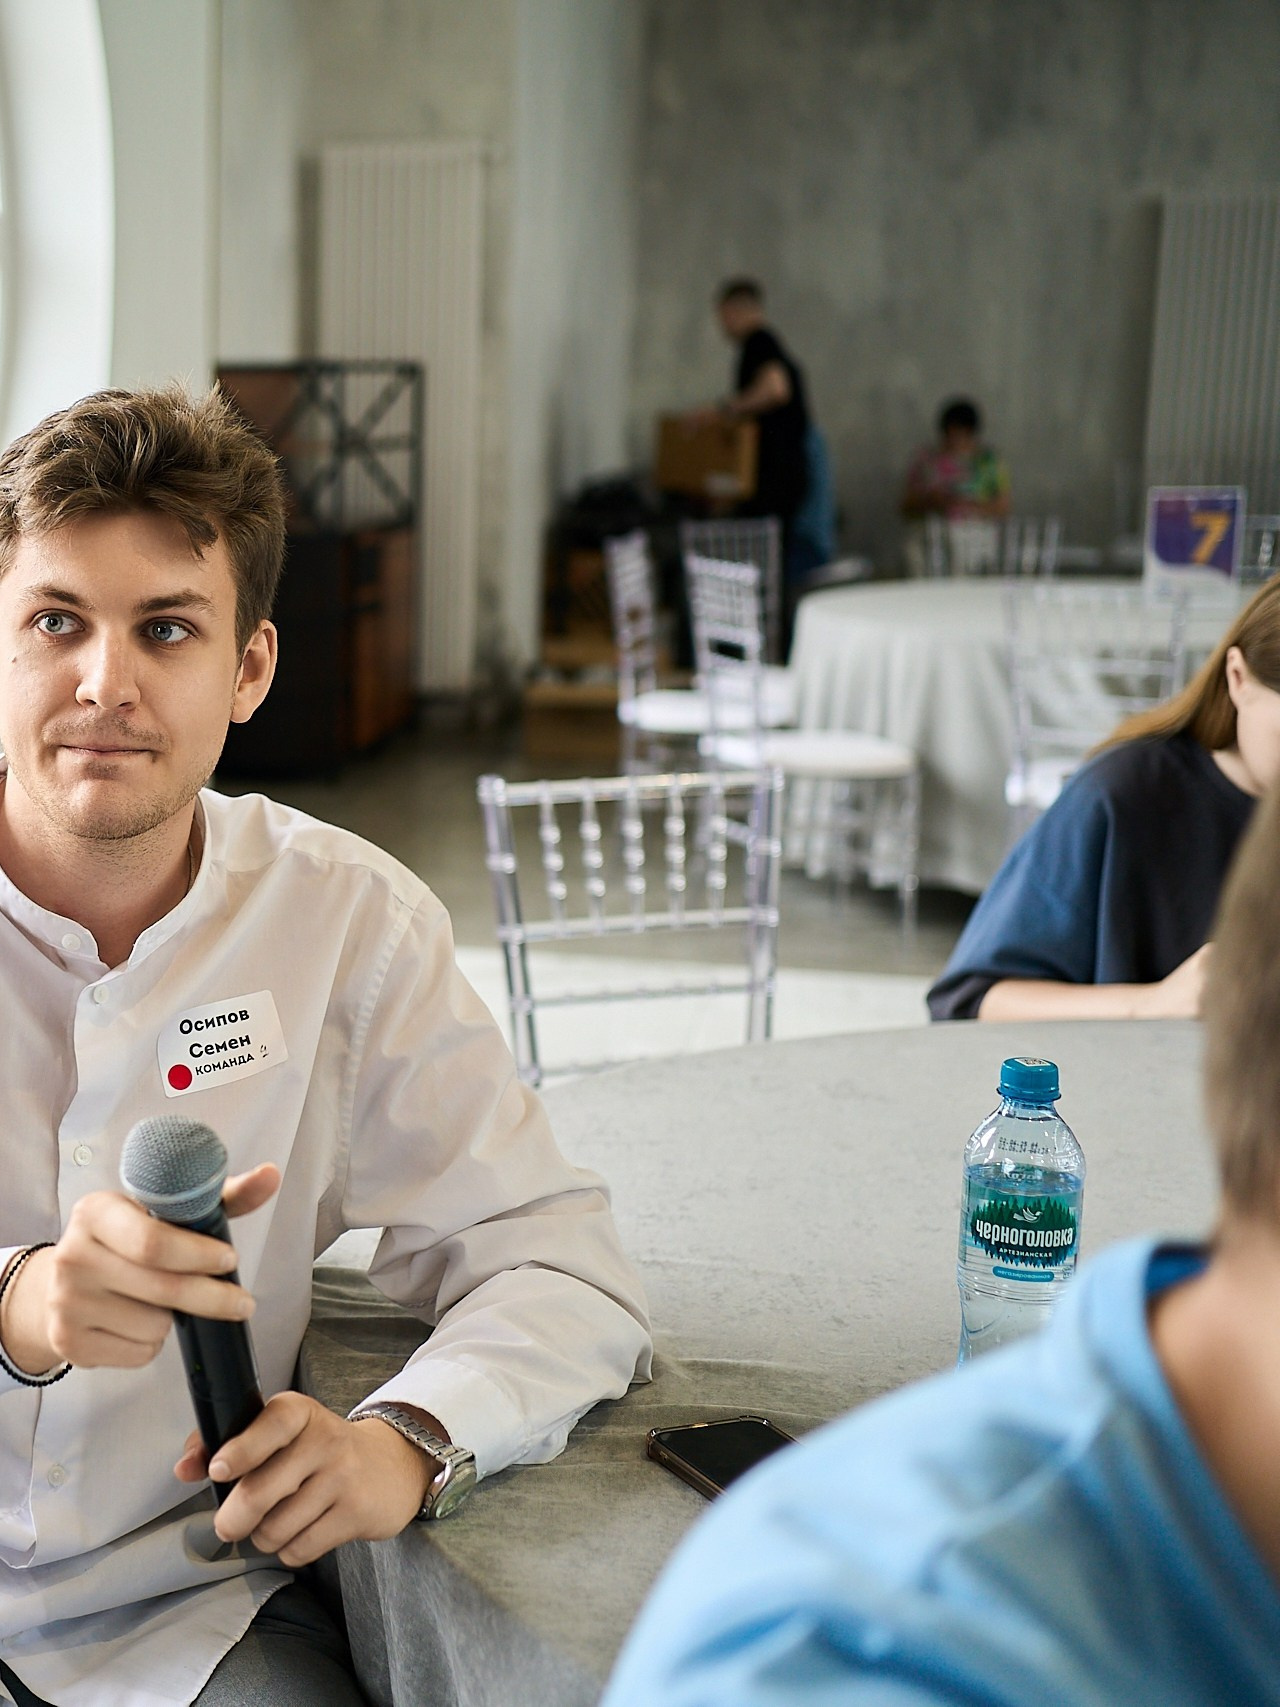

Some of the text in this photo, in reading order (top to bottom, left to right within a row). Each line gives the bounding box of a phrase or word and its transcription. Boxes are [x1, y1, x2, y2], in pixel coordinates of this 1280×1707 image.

[1189, 510, 1231, 566] 7
[179, 1009, 250, 1035] Осипов
[189, 1034, 252, 1058] Семен
[195, 1053, 255, 1075] КОМАНДА
[999, 1247, 1053, 1258] АРТЕЗИАНСКАЯ
